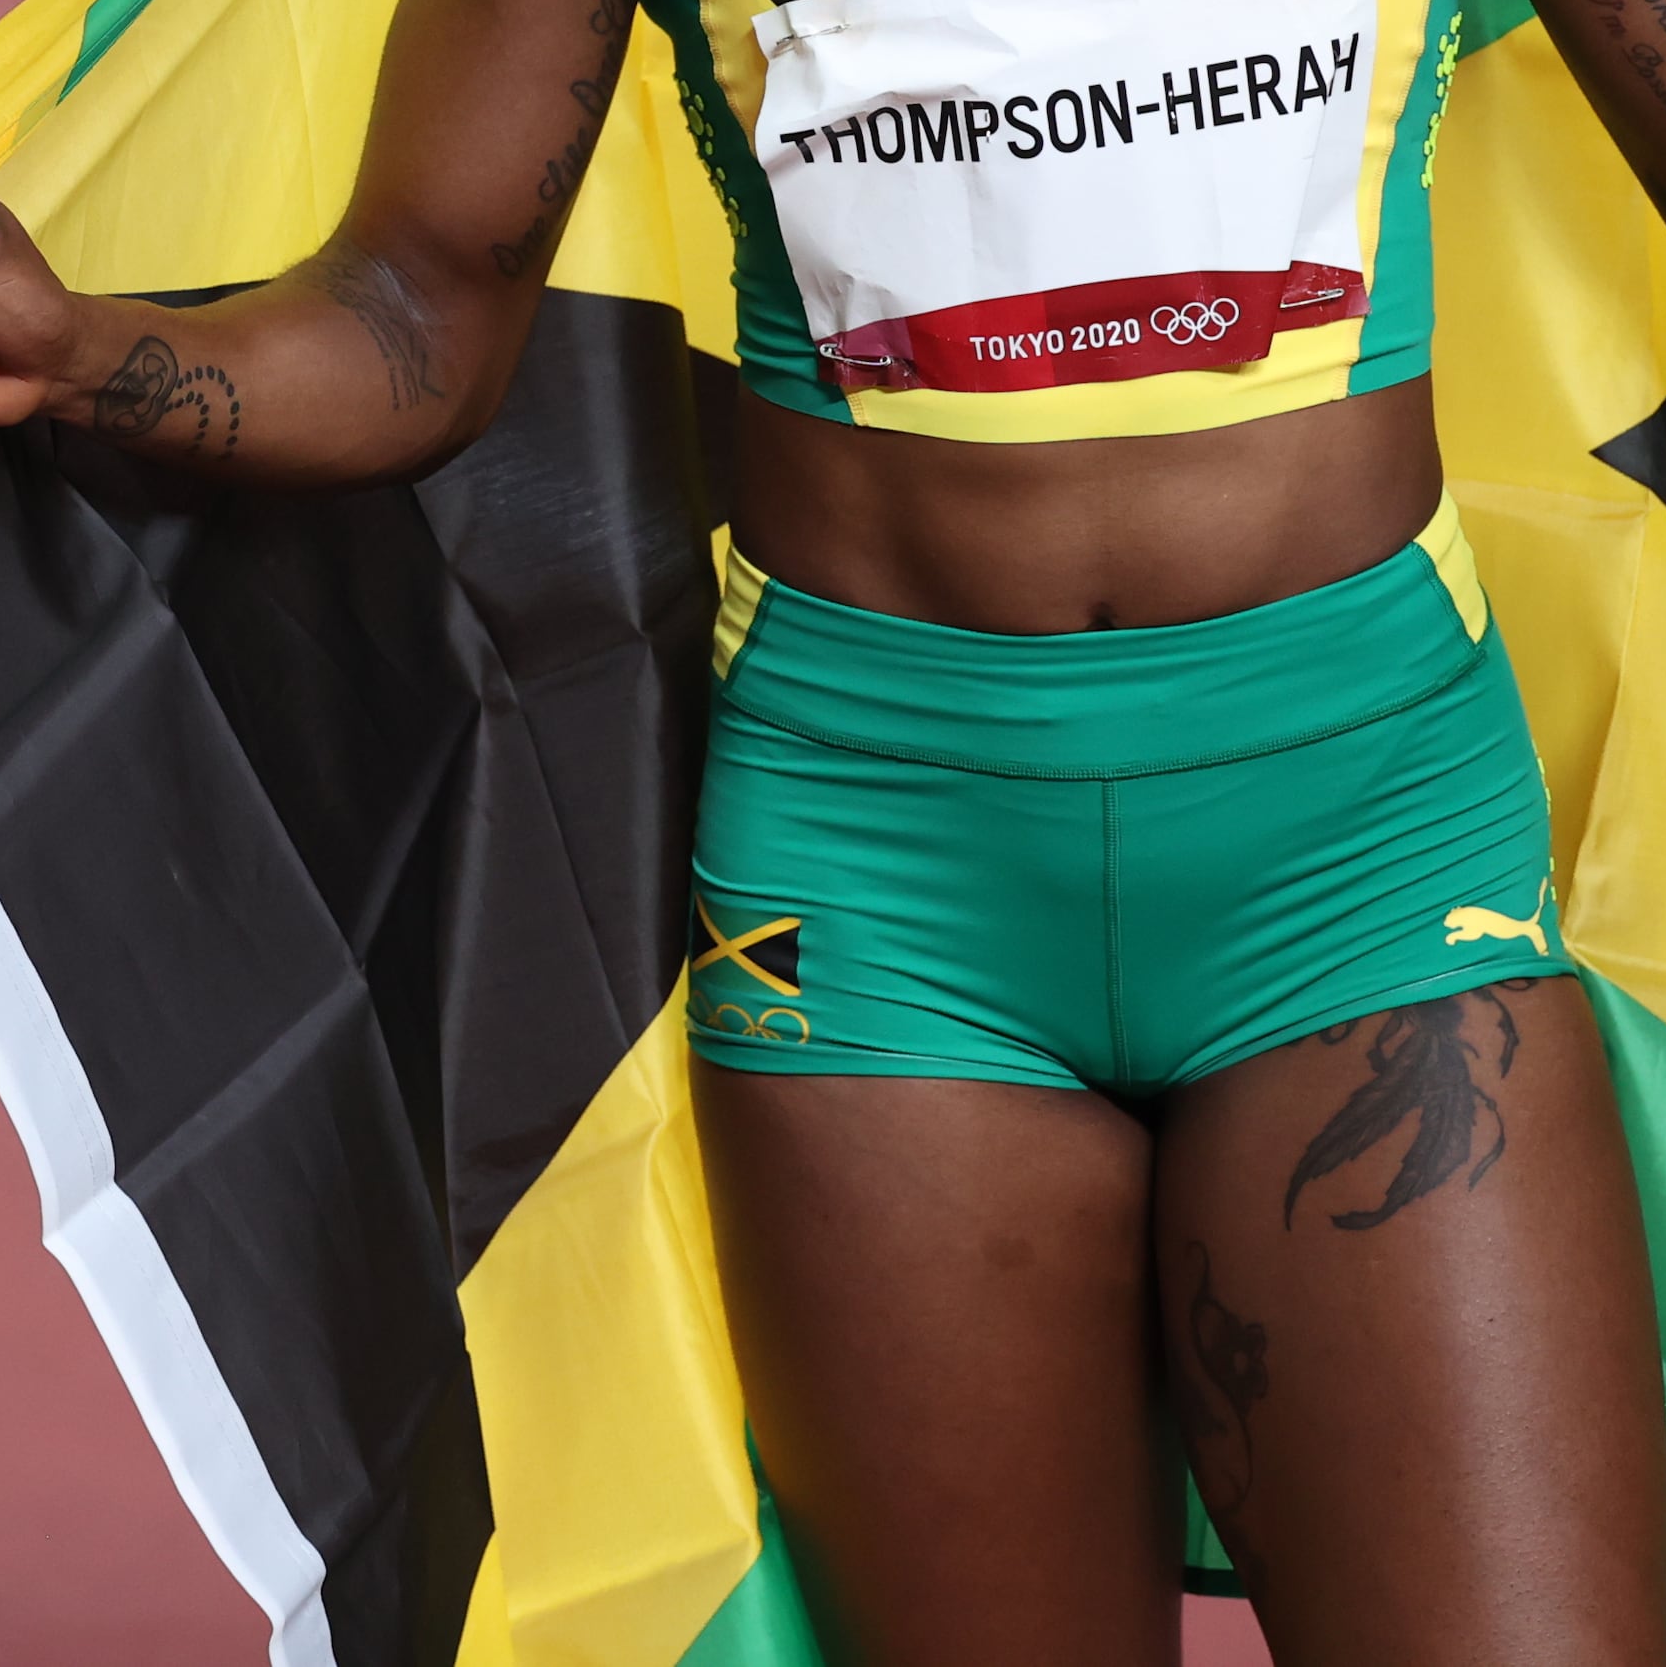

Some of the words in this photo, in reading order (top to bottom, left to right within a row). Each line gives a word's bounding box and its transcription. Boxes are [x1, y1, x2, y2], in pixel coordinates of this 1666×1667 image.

[779, 31, 1360, 164] THOMPSON-HERAH
[969, 331, 1065, 363] TOKYO
[1070, 317, 1141, 351] 2020
